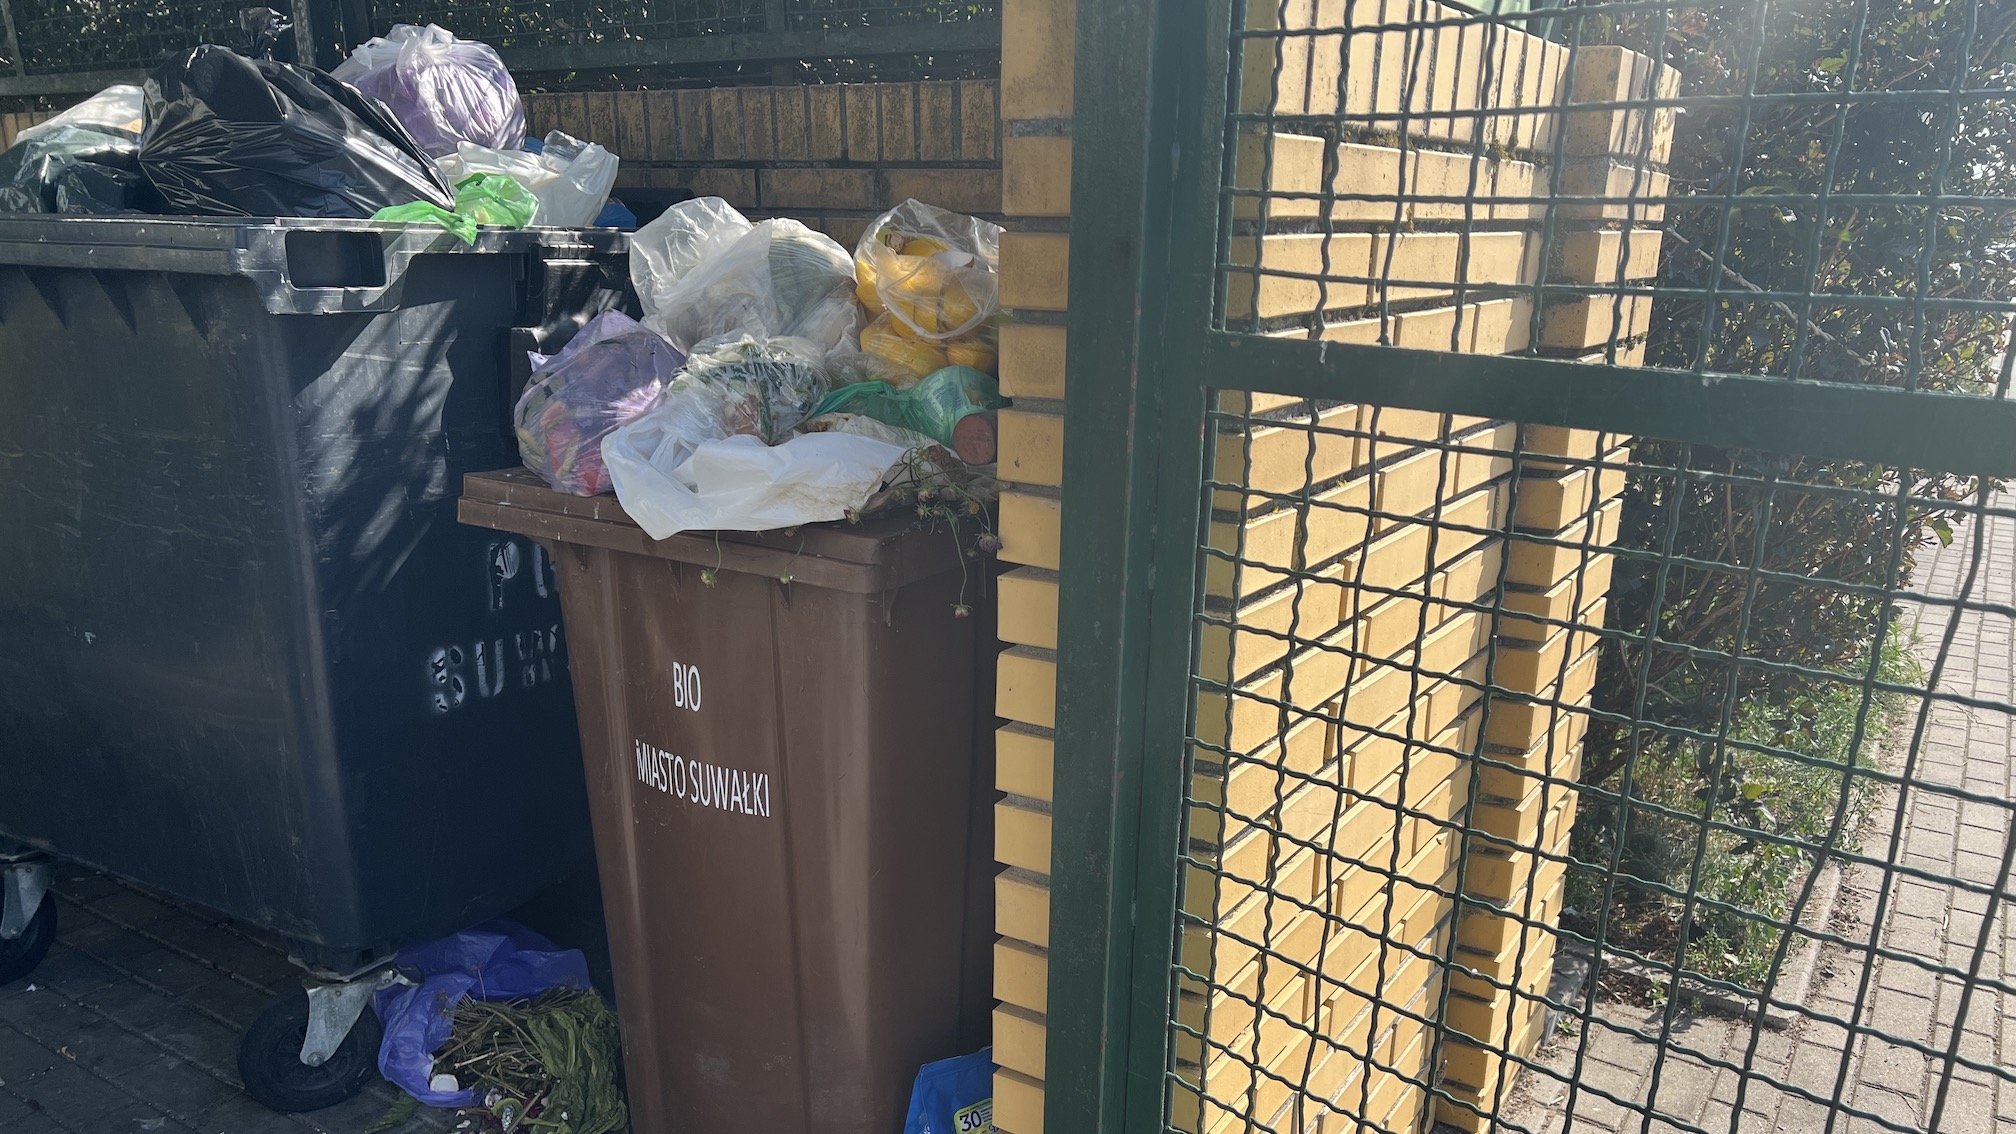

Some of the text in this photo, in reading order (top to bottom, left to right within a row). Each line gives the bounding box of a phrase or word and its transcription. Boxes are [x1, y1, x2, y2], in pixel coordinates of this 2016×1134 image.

[673, 661, 701, 712] BIO
[636, 739, 770, 818] MIASTO SUWAŁKI
[959, 1110, 982, 1132] 30
